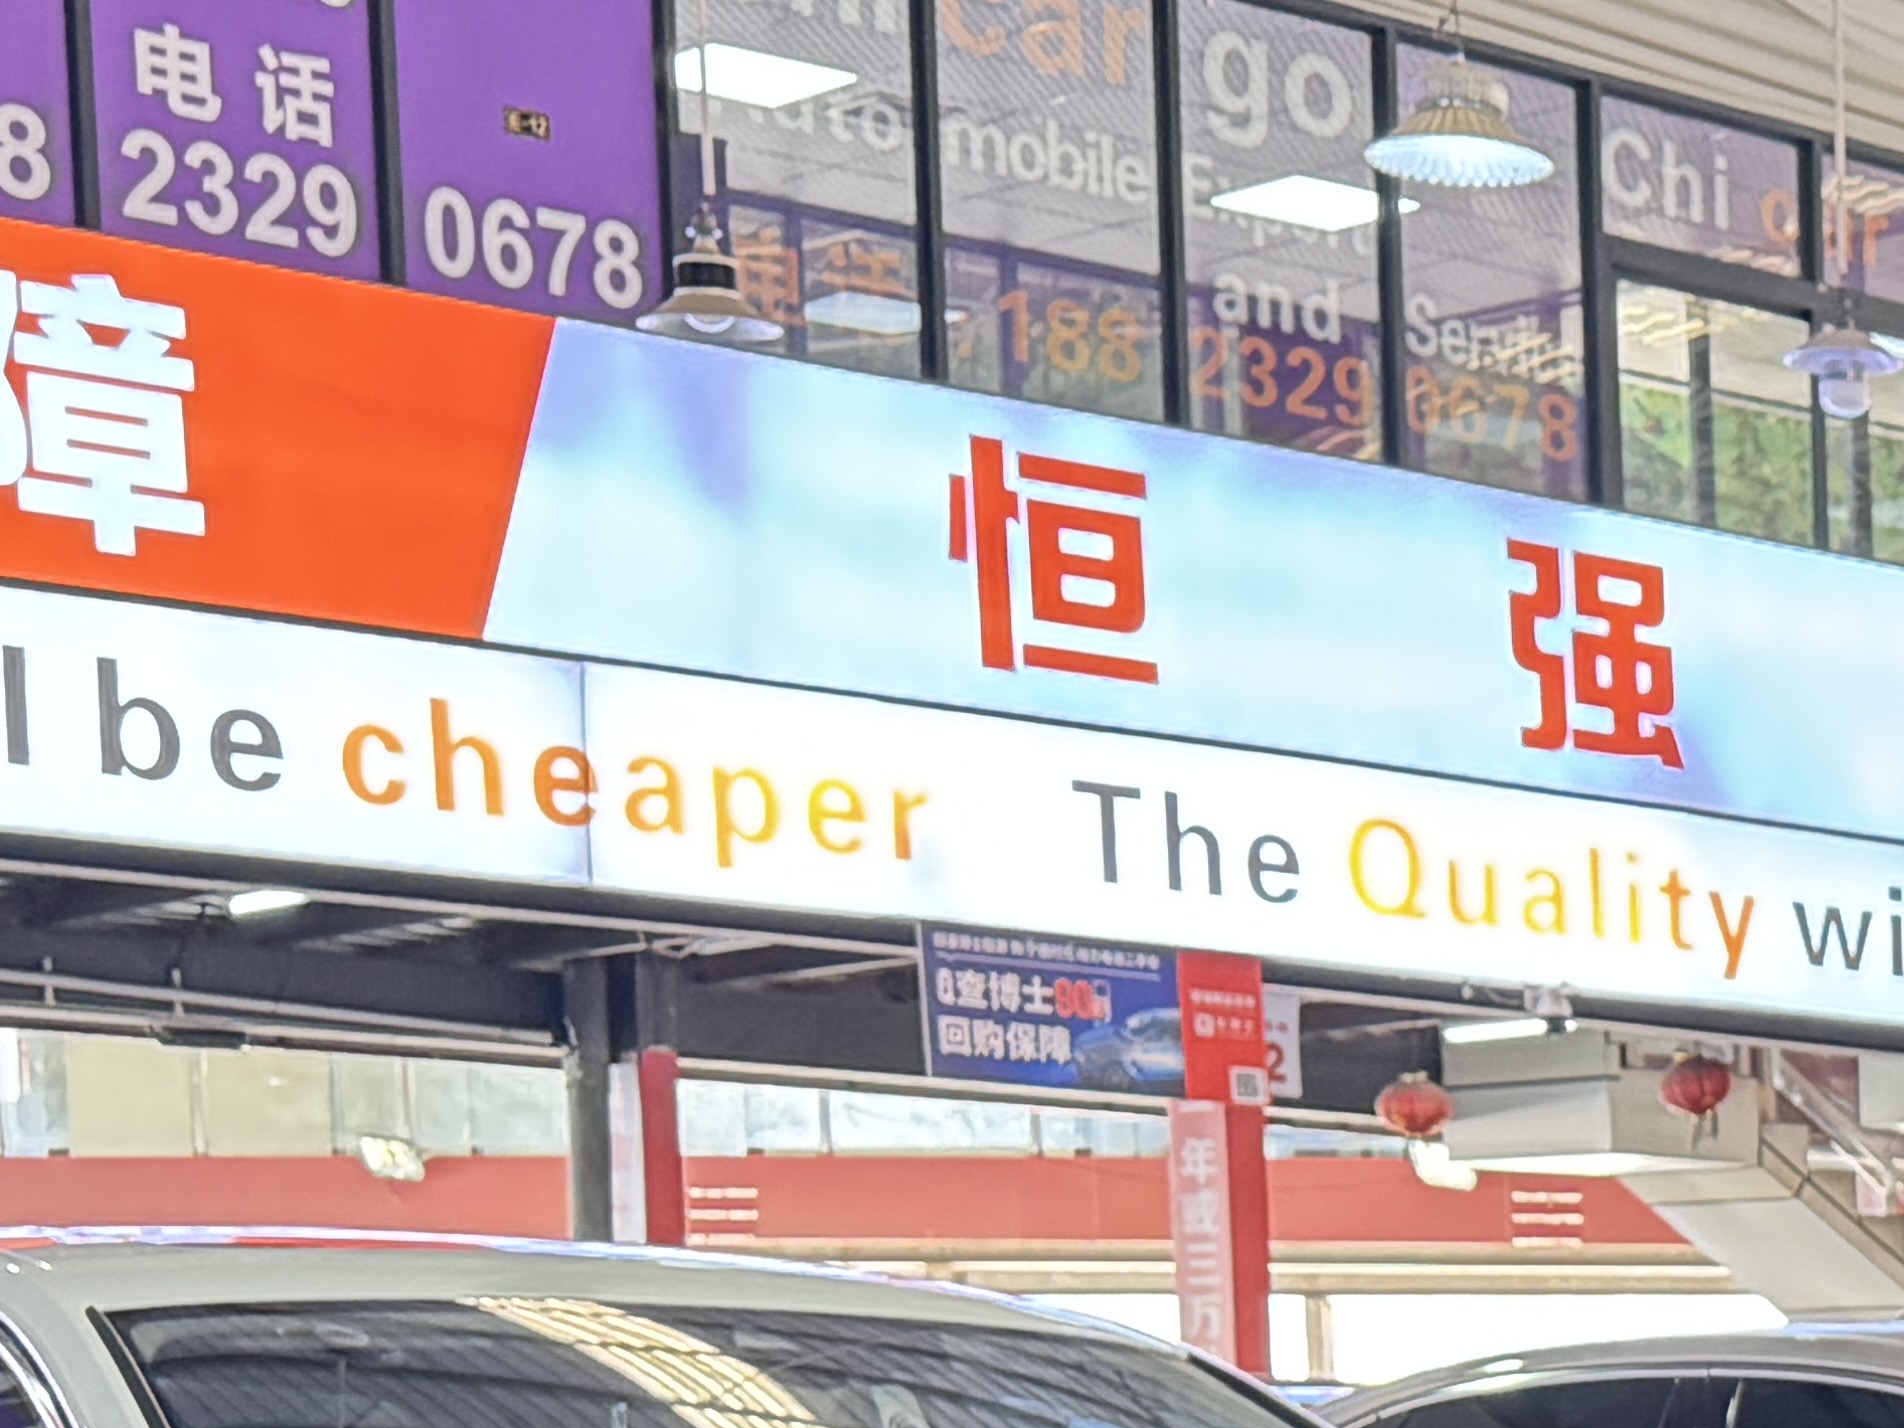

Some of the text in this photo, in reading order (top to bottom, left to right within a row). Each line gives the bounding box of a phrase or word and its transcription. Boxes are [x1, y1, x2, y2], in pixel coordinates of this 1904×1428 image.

[133, 23, 336, 148] 电话
[121, 129, 359, 258] 2329
[424, 186, 645, 310] 0678
[998, 290, 1142, 383] 188
[1190, 327, 1371, 426] 2329
[1213, 273, 1341, 345] and
[96, 657, 284, 792] be
[341, 697, 930, 868] cheaper
[1071, 780, 1302, 905] The
[1348, 818, 1755, 981] Quality
